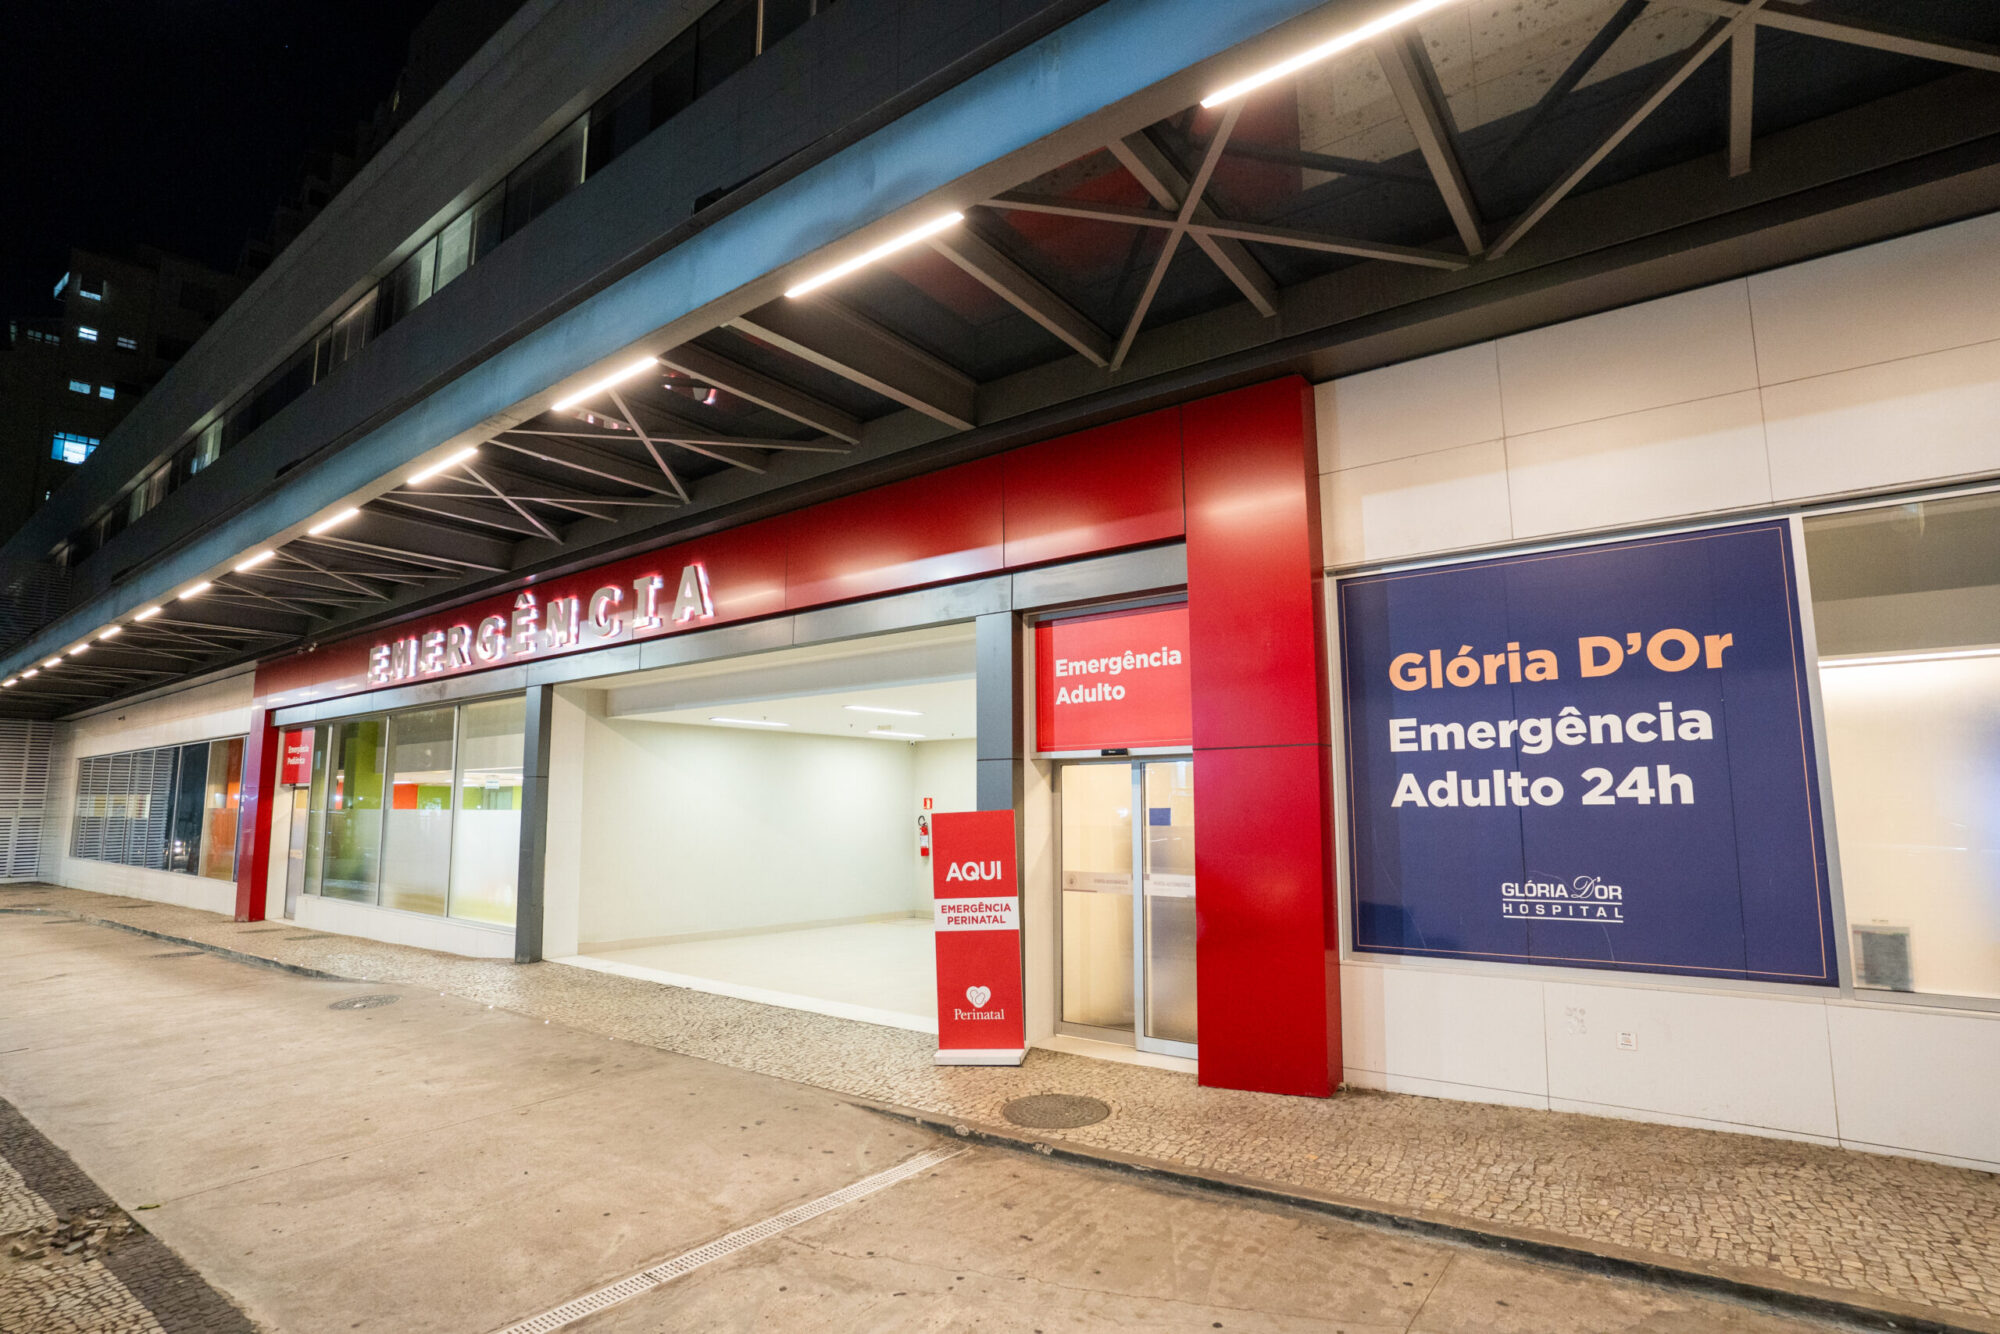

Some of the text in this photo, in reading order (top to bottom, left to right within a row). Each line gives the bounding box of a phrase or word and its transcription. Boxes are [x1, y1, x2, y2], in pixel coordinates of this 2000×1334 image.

[367, 563, 714, 684] EMERGÊNCIA
[1055, 646, 1182, 677] Emergência
[1389, 628, 1734, 691] Glória D'Or
[1055, 682, 1126, 705] Adulto
[1389, 701, 1714, 755] Emergência
[1391, 764, 1695, 808] Adulto 24h
[945, 860, 1002, 882] AQUI
[1501, 880, 1569, 898] GLÓRIA
[941, 901, 1012, 914] EMERGÊNCIA
[1502, 903, 1624, 918] HOSPITAL
[947, 915, 1007, 925] PERINATAL
[954, 1008, 1005, 1021] Perinatal
